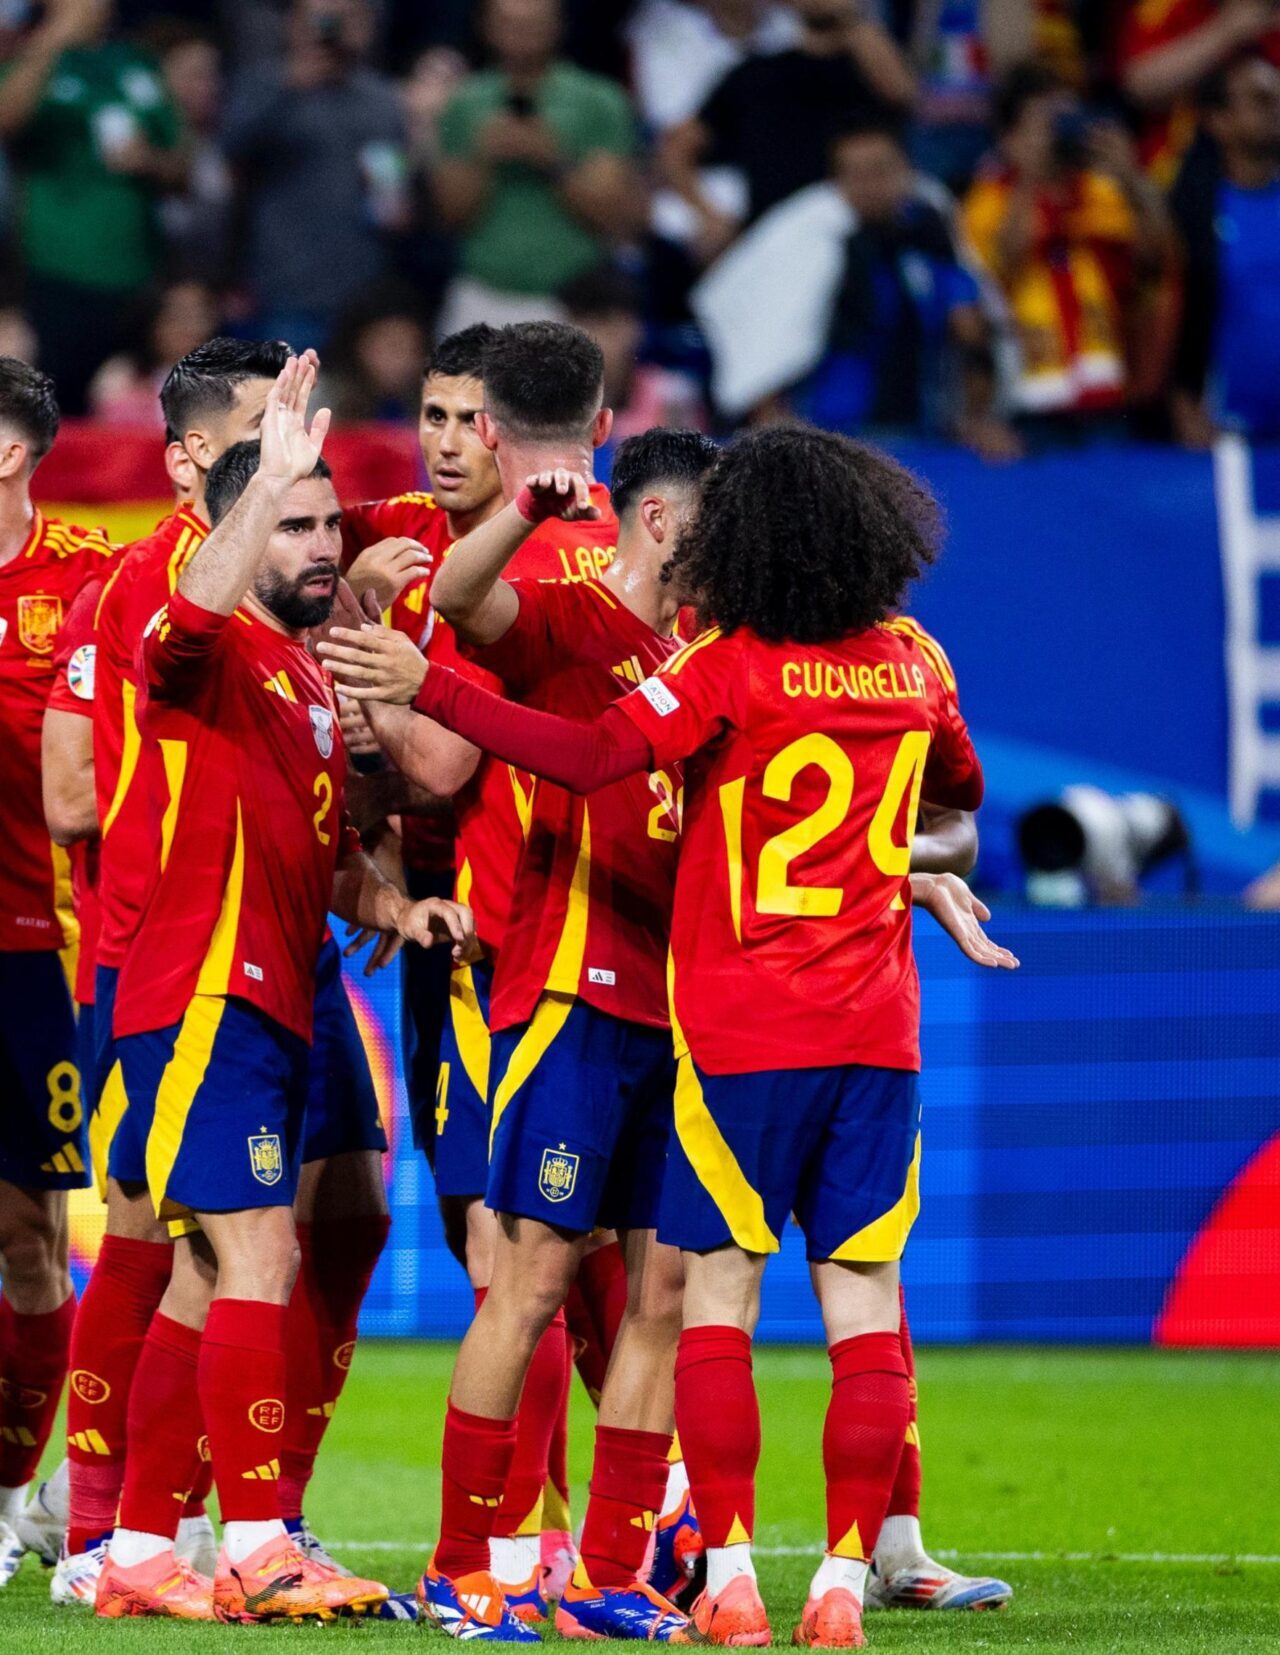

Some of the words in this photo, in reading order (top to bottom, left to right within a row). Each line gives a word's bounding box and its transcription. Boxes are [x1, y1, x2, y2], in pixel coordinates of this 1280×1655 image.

[782, 661, 927, 699] CUCURELLA
[313, 771, 333, 846] 2
[648, 770, 684, 843] 2
[756, 731, 930, 916] 24
[46, 1060, 83, 1133] 8
